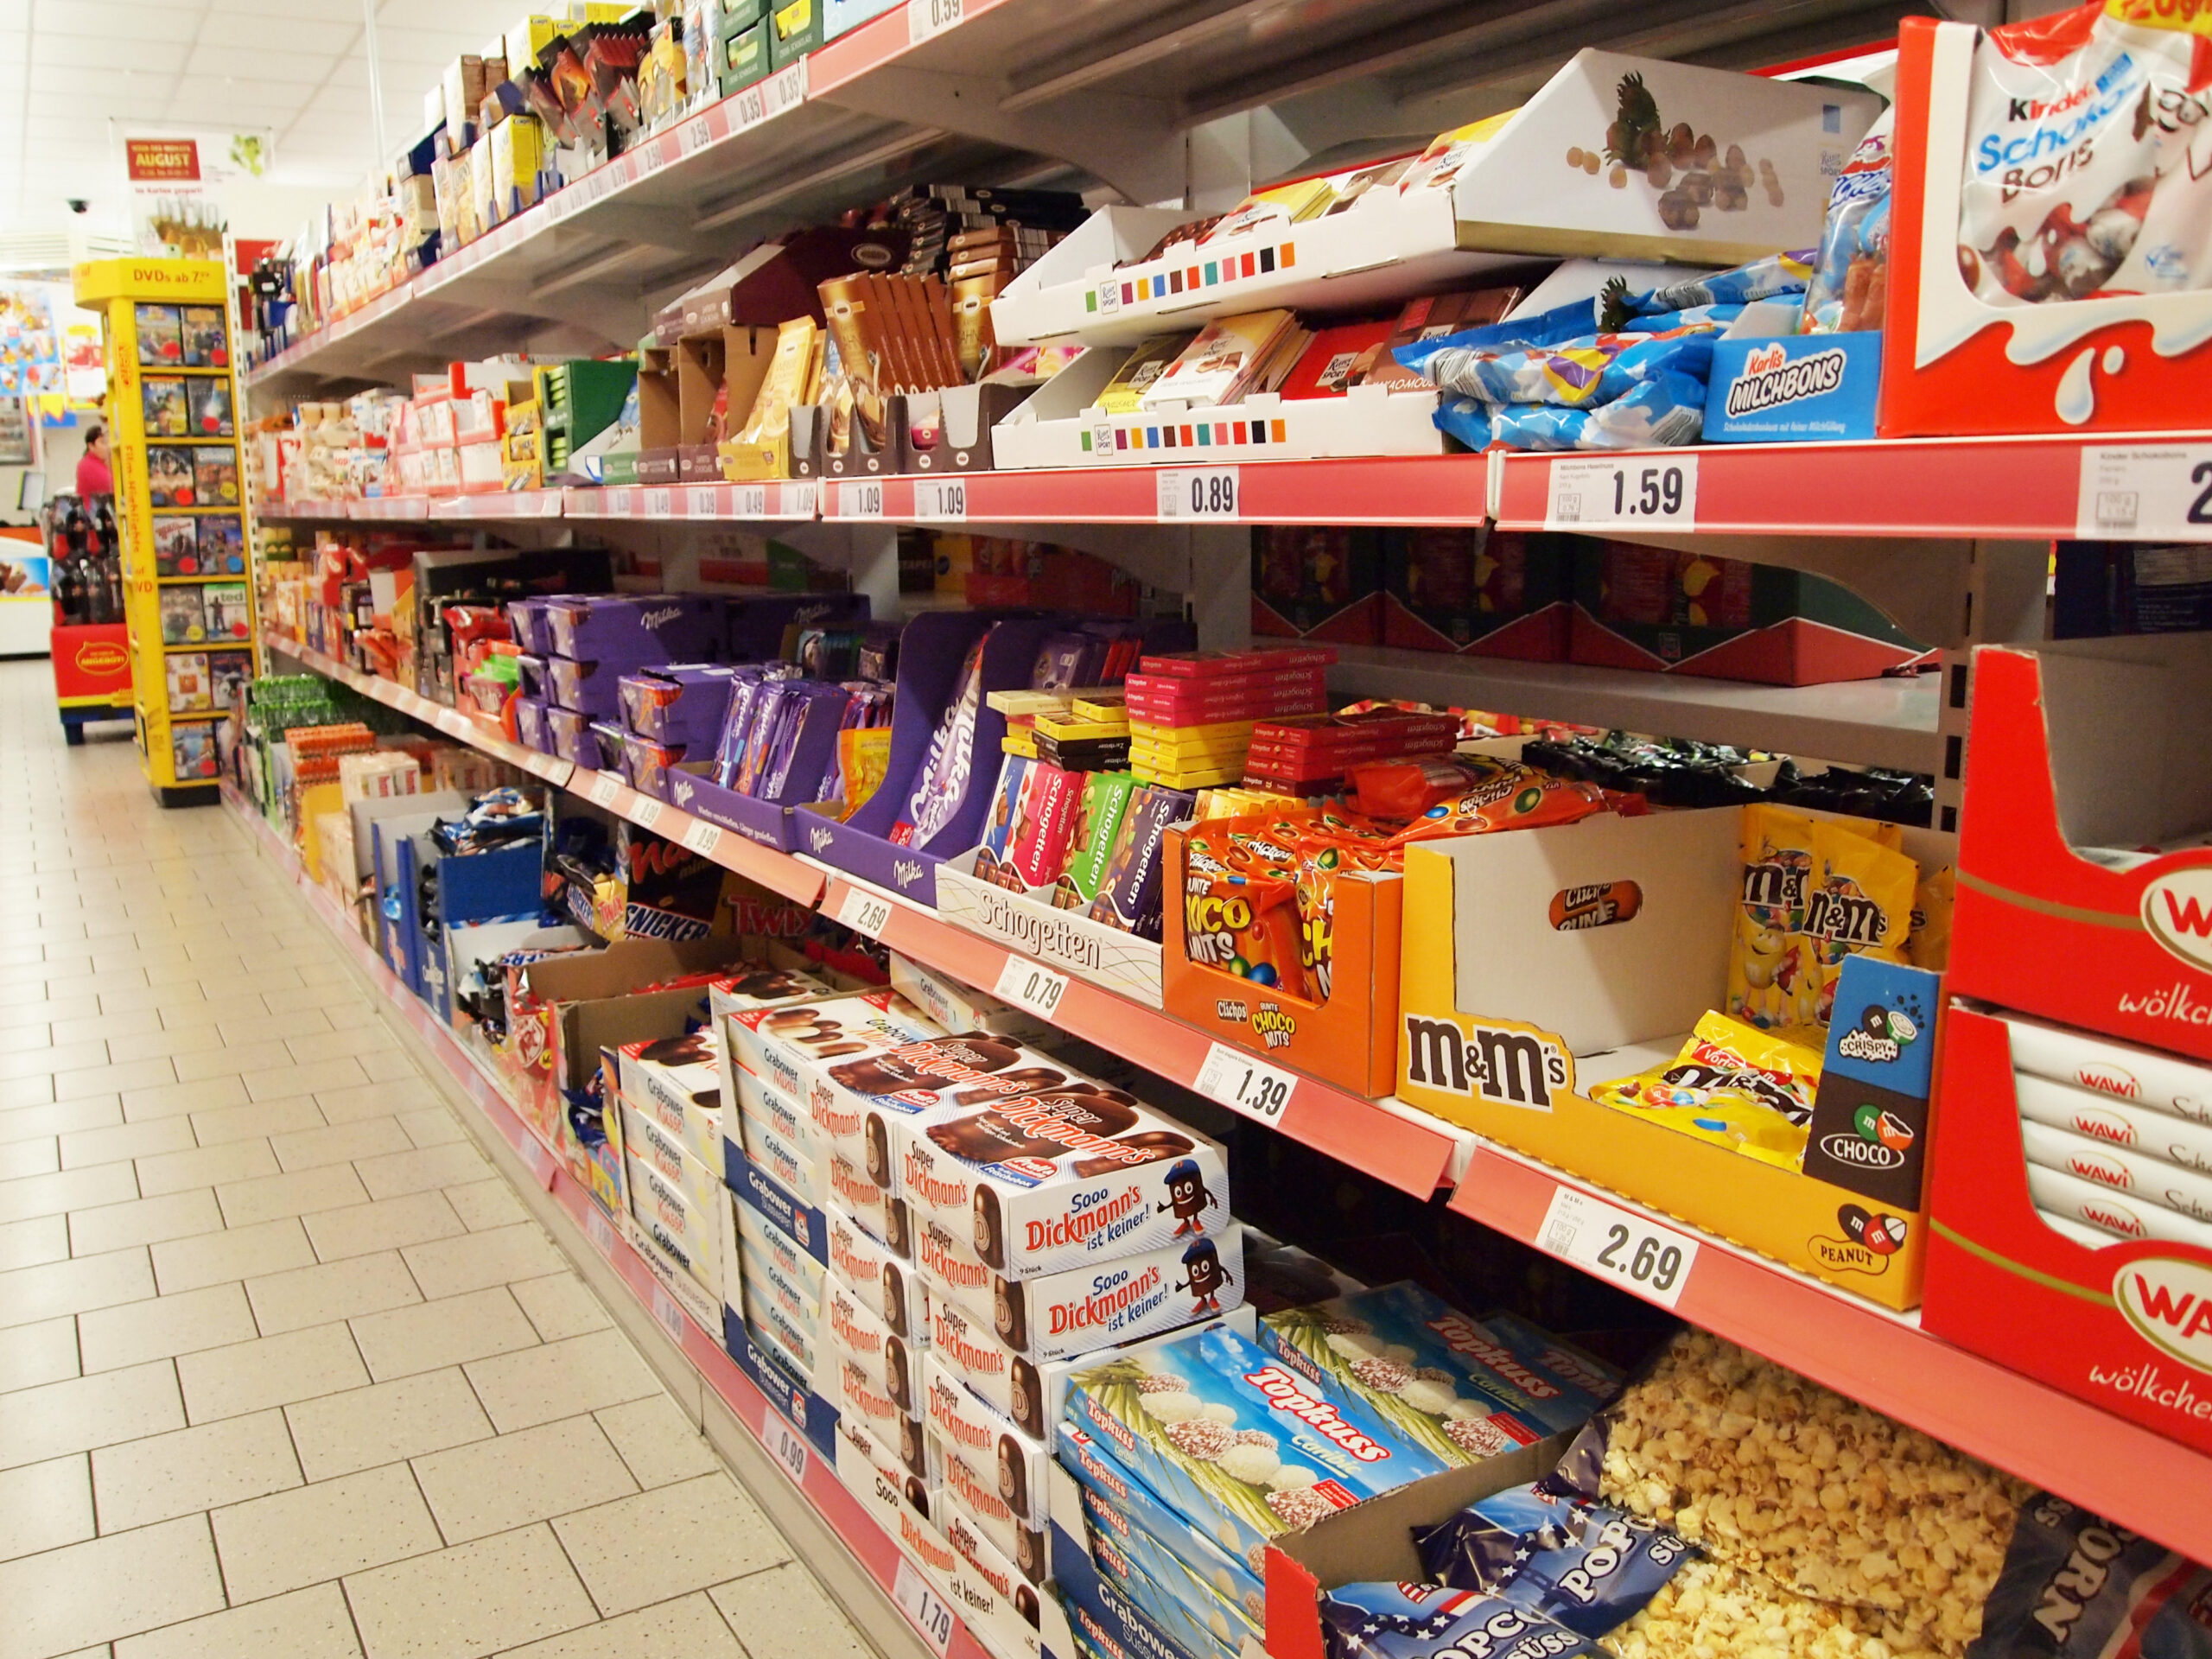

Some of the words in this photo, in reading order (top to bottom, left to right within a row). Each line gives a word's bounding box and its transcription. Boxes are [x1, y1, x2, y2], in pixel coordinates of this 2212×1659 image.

[779, 73, 799, 105] 0.35
[741, 94, 760, 124] 0.35
[137, 153, 189, 167] AUGUST
[134, 269, 171, 283] DVDs
[175, 270, 188, 283] ab
[1321, 369, 1345, 379] SPORT
[1749, 349, 1784, 375] Karlis
[1729, 353, 1844, 416] MILCHBONS
[746, 491, 763, 514] 0.49
[797, 488, 814, 512] 1.09
[858, 487, 880, 513] 1.09
[938, 486, 963, 515] 1.09
[1192, 475, 1234, 512] 0.89
[1613, 467, 1683, 515] 1.59
[220, 588, 244, 603] ted
[640, 607, 683, 630] Milka
[674, 780, 694, 807] Milka
[1058, 787, 1074, 834] Schogetten
[639, 803, 658, 824] 0.99
[1030, 774, 1062, 873] Schogetten
[696, 827, 718, 851] 0.99
[810, 826, 834, 854] Milka
[1089, 784, 1123, 887] Schogetten
[1128, 800, 1170, 906] Schogetten
[893, 860, 924, 888] Milka
[858, 901, 887, 931] 2.69
[978, 888, 1100, 969] Schogetten
[2164, 888, 2212, 938] WA
[920, 978, 949, 1008] Grabower
[1023, 972, 1061, 1009] 0.79
[1260, 1002, 1279, 1012] BUNTE
[1217, 1000, 1248, 1020] Clichos
[1252, 1012, 1296, 1035] CHOCO
[946, 1042, 988, 1064] Super
[1265, 1030, 1291, 1049] NUTS
[1847, 1039, 1889, 1053] CRISPY
[765, 1048, 798, 1080] Grabower
[888, 1041, 1030, 1095] Dickmann's
[1407, 1016, 1566, 1110] m&m's
[1704, 1048, 1739, 1069] Vorte
[648, 1077, 683, 1116] Grabower
[763, 1091, 797, 1123] Grabower
[815, 1079, 834, 1103] Super
[1236, 1069, 1287, 1116] 1.39
[810, 1091, 861, 1138] Dickmann's
[1045, 1094, 1103, 1126] Super
[646, 1125, 682, 1164] Grabower
[989, 1096, 1155, 1164] Dickmann's
[765, 1135, 798, 1167] Grabower
[912, 1141, 934, 1171] Super
[1834, 1138, 1891, 1166] CHOCO
[649, 1174, 685, 1215] Grabower
[748, 1172, 791, 1217] Grabower
[830, 1159, 880, 1207] Dickmann's
[905, 1154, 967, 1210] Dickmann's
[1071, 1188, 1108, 1213] Sooo
[836, 1221, 853, 1249] Super
[927, 1220, 952, 1251] Super
[1026, 1185, 1141, 1250] Dickmann's
[1088, 1236, 1103, 1250] ist
[1108, 1204, 1150, 1241] keiner!
[654, 1223, 690, 1268] Grabower
[830, 1231, 878, 1281] Dickmann's
[921, 1231, 988, 1288] Dickmann's
[1598, 1224, 1681, 1291] 2.69
[1820, 1244, 1875, 1267] PEANUT
[1026, 1264, 1042, 1274] Stück
[1093, 1270, 1128, 1295] Sooo
[836, 1290, 854, 1318] Super
[1049, 1266, 1160, 1334] Dickmann's
[1108, 1317, 1123, 1332] ist
[1128, 1284, 1167, 1323] keiner!
[2133, 1274, 2212, 1340] WA
[830, 1301, 880, 1352] Dickmann's
[943, 1303, 968, 1335] Super
[935, 1315, 1004, 1374] Dickmann's
[1049, 1347, 1065, 1357] Stück
[1278, 1338, 1320, 1384] Topkuss
[1426, 1317, 1562, 1400] Topkuss
[747, 1344, 790, 1395] Grabower
[772, 1348, 807, 1388] Grabower
[842, 1366, 895, 1417] Dickmann's
[936, 1376, 958, 1408] Super
[929, 1386, 992, 1450] Dickmann's
[1088, 1397, 1134, 1451] Topkuss
[1245, 1367, 1391, 1462] Topkuss
[780, 1431, 804, 1475] 0.99
[852, 1426, 873, 1457] Super
[947, 1453, 1010, 1521] Dickmann's
[1079, 1446, 1127, 1499] Topkuss
[876, 1478, 898, 1507] Sooo
[1084, 1485, 1128, 1537] Topkuss
[900, 1511, 956, 1572] Dickmann's
[955, 1518, 978, 1553] Super
[950, 1577, 961, 1598] ist
[964, 1580, 994, 1615] keiner!
[920, 1592, 950, 1645] 1.79
[1079, 1606, 1124, 1659] Topkuss
